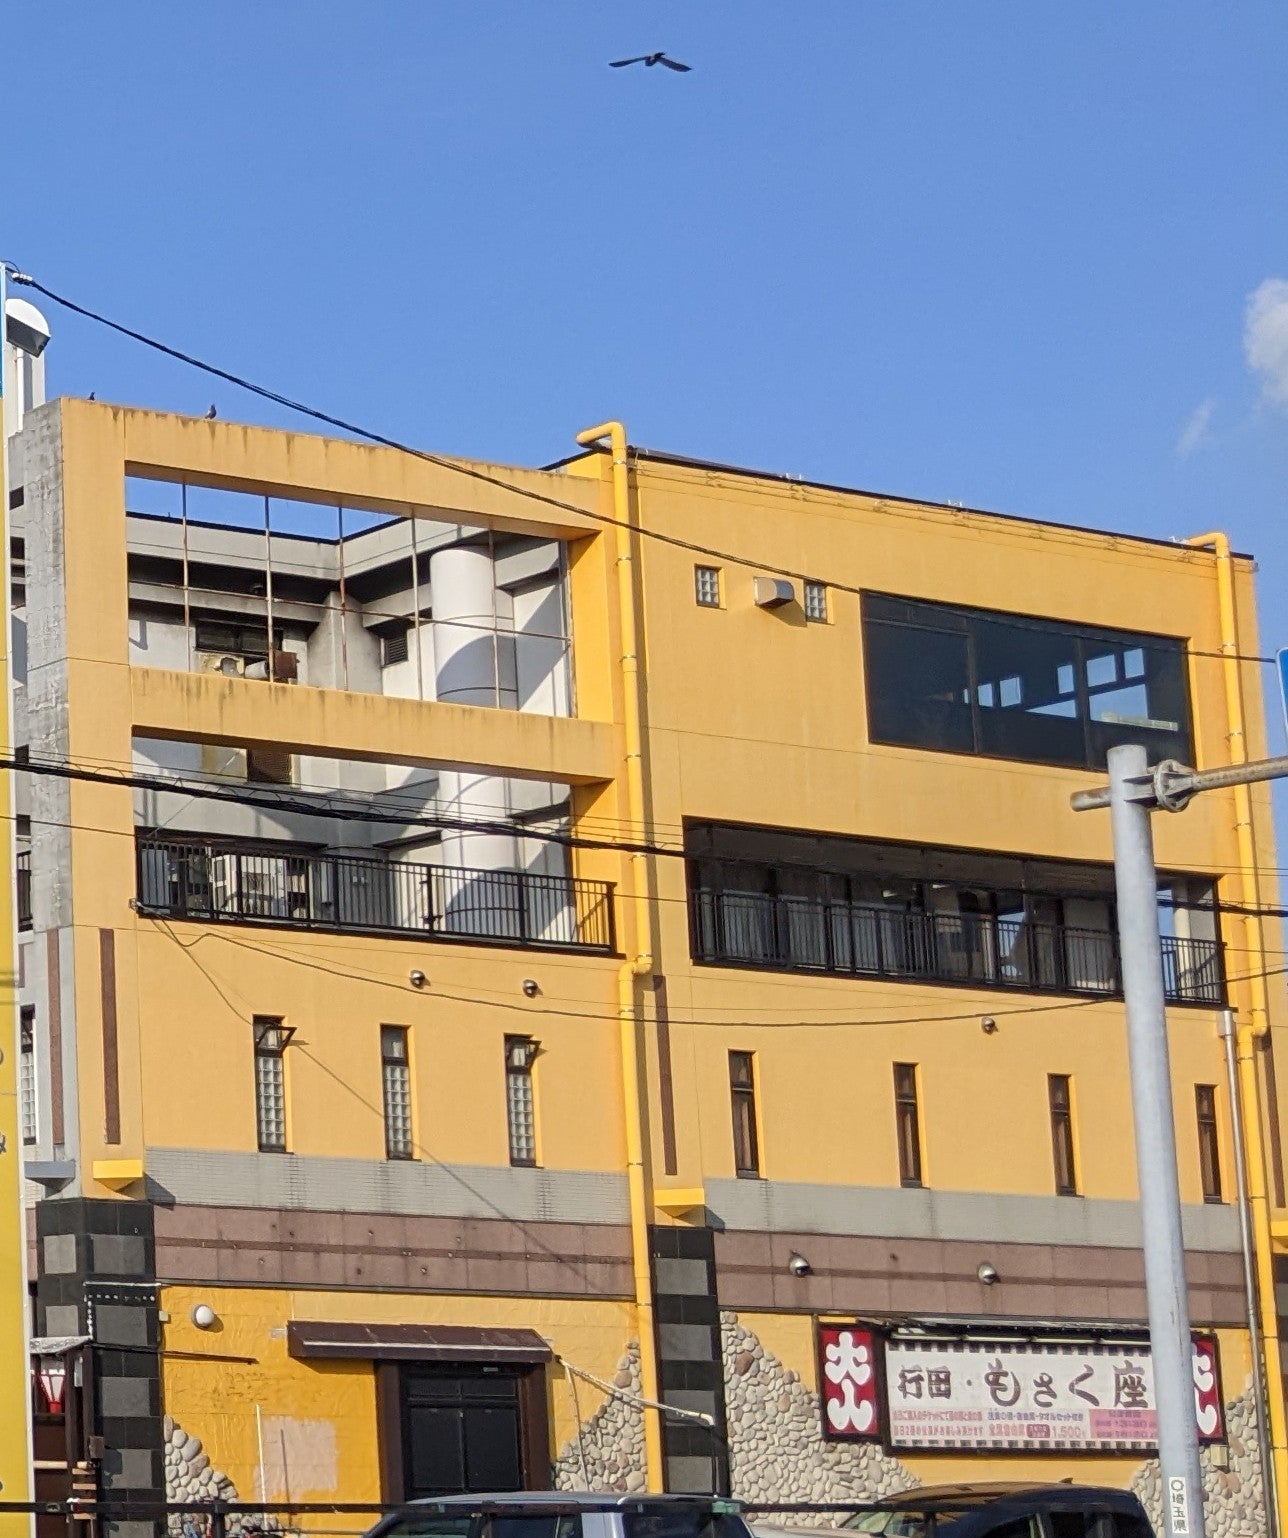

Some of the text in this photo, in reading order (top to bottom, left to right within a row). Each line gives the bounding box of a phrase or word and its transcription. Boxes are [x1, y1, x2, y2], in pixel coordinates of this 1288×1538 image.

[897, 1357, 1150, 1409] 行田・もさく座
